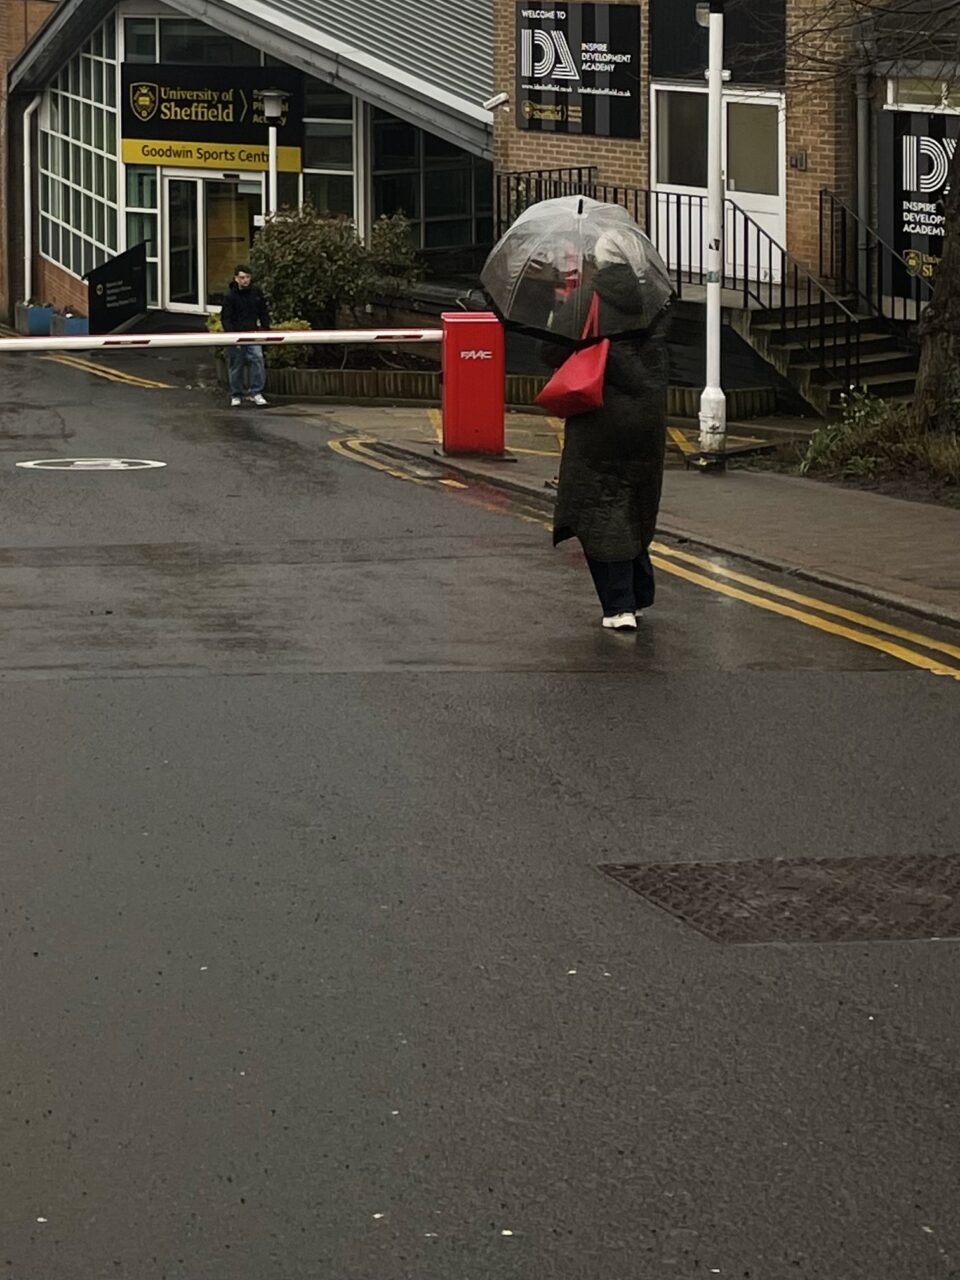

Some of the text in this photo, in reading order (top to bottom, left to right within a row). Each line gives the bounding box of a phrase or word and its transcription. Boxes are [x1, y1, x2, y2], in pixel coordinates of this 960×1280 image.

[521, 9, 566, 20] WELCOME TO
[581, 42, 607, 52] INSPIRE
[581, 52, 632, 63] DEVELOPMENT
[581, 62, 615, 72] ACADEMY
[160, 87, 234, 104] University of
[160, 102, 234, 122] Sheffield
[141, 144, 193, 159] Goodwin
[196, 147, 235, 163] Sports
[903, 201, 936, 213] INSPIRE
[460, 350, 492, 360] FAAC
